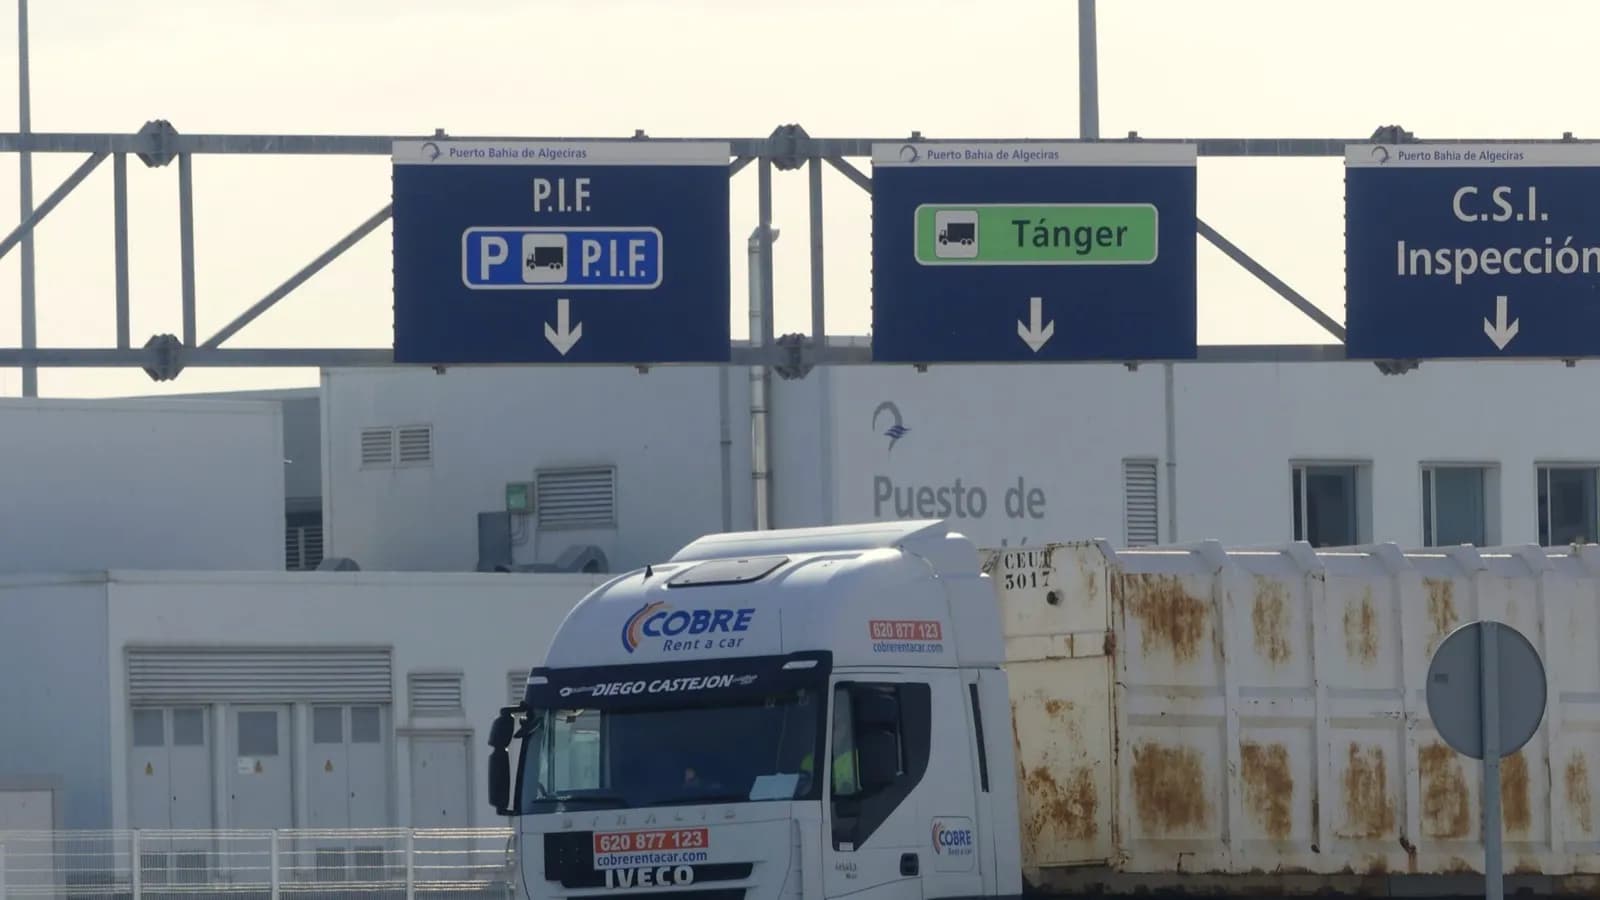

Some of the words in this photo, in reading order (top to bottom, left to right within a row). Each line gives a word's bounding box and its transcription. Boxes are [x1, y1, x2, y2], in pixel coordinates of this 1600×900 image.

[449, 147, 485, 158] Puerto
[521, 147, 535, 158] de
[538, 147, 587, 161] Algeciras
[927, 149, 962, 160] Puerto
[996, 149, 1009, 160] de
[1011, 149, 1059, 163] Algeciras
[1398, 150, 1432, 161] Puerto
[1463, 150, 1477, 161] de
[1478, 150, 1524, 164] Algeciras
[533, 177, 591, 212] P.I.F.
[1452, 185, 1549, 222] C.S.I.
[1011, 217, 1128, 256] Tánger
[480, 235, 509, 281] P
[582, 239, 646, 277] P.I.F.
[1397, 236, 1600, 285] Inspección
[873, 475, 987, 519] Puesto
[1004, 476, 1046, 519] de
[642, 607, 756, 637] COBRE
[873, 622, 893, 638] 620
[663, 639, 700, 652] Rent
[704, 639, 713, 649] a
[718, 637, 744, 649] car
[592, 680, 646, 697] DIEGO
[648, 673, 735, 693] CASTEJON
[600, 834, 630, 852] 620
[635, 832, 666, 849] 877
[671, 831, 703, 847] 123
[938, 830, 972, 846] COBRE
[597, 851, 708, 866] cobrerentacar.com
[605, 865, 694, 889] IVECO
